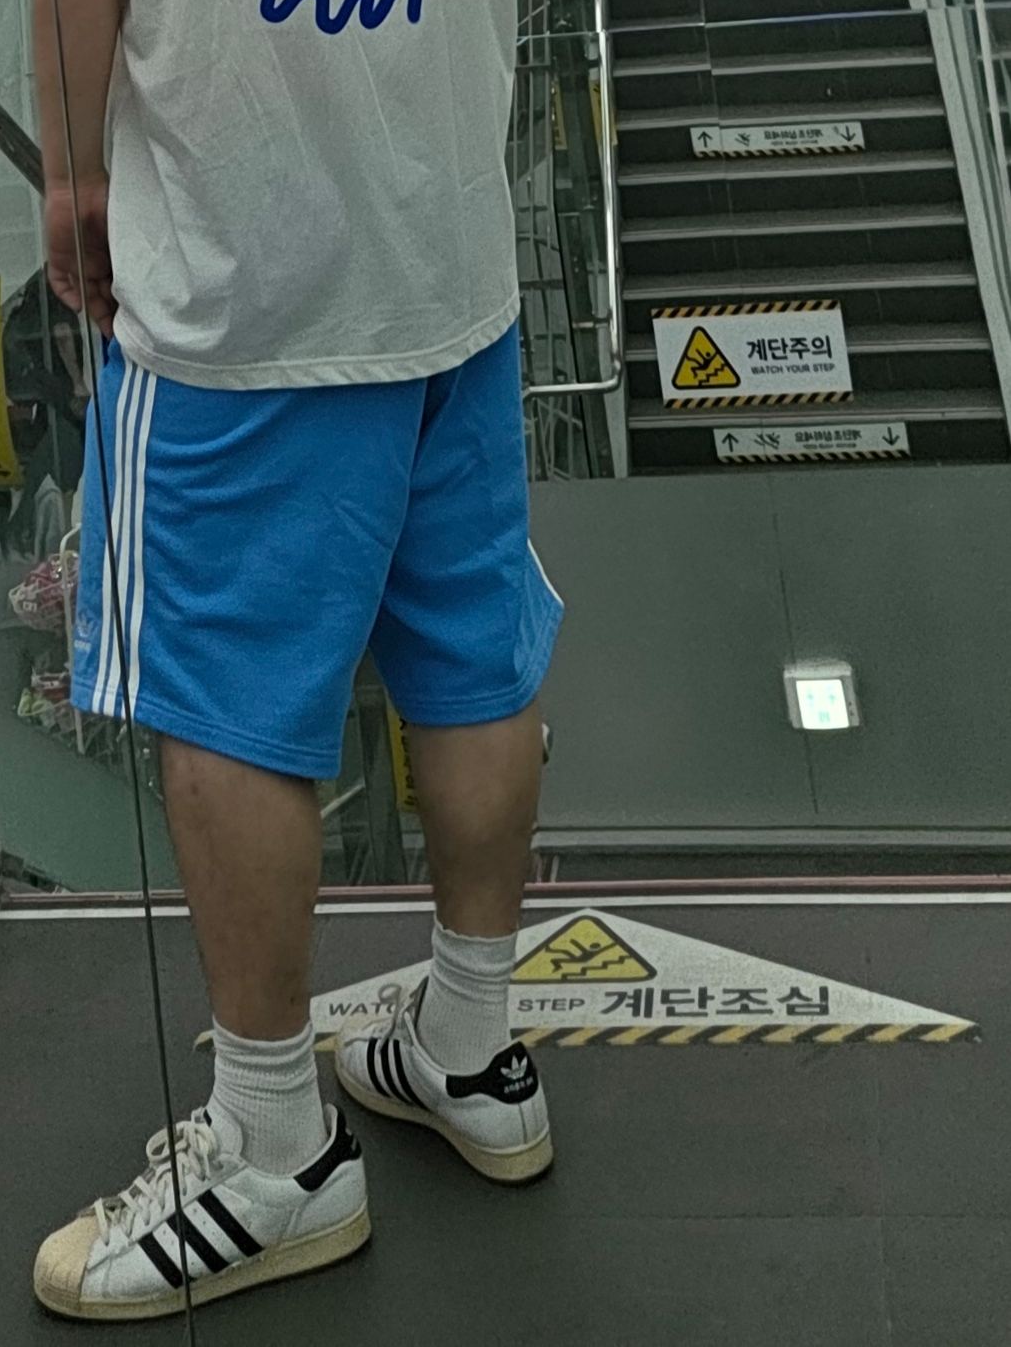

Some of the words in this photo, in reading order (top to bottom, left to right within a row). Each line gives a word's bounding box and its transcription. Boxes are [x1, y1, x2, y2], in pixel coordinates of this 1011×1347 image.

[746, 335, 832, 361] 계단주의
[750, 364, 783, 376] WATCH
[786, 363, 810, 374] YOUR
[813, 362, 836, 373] STEP
[517, 997, 586, 1012] STEP
[601, 986, 831, 1018] 계단조심
